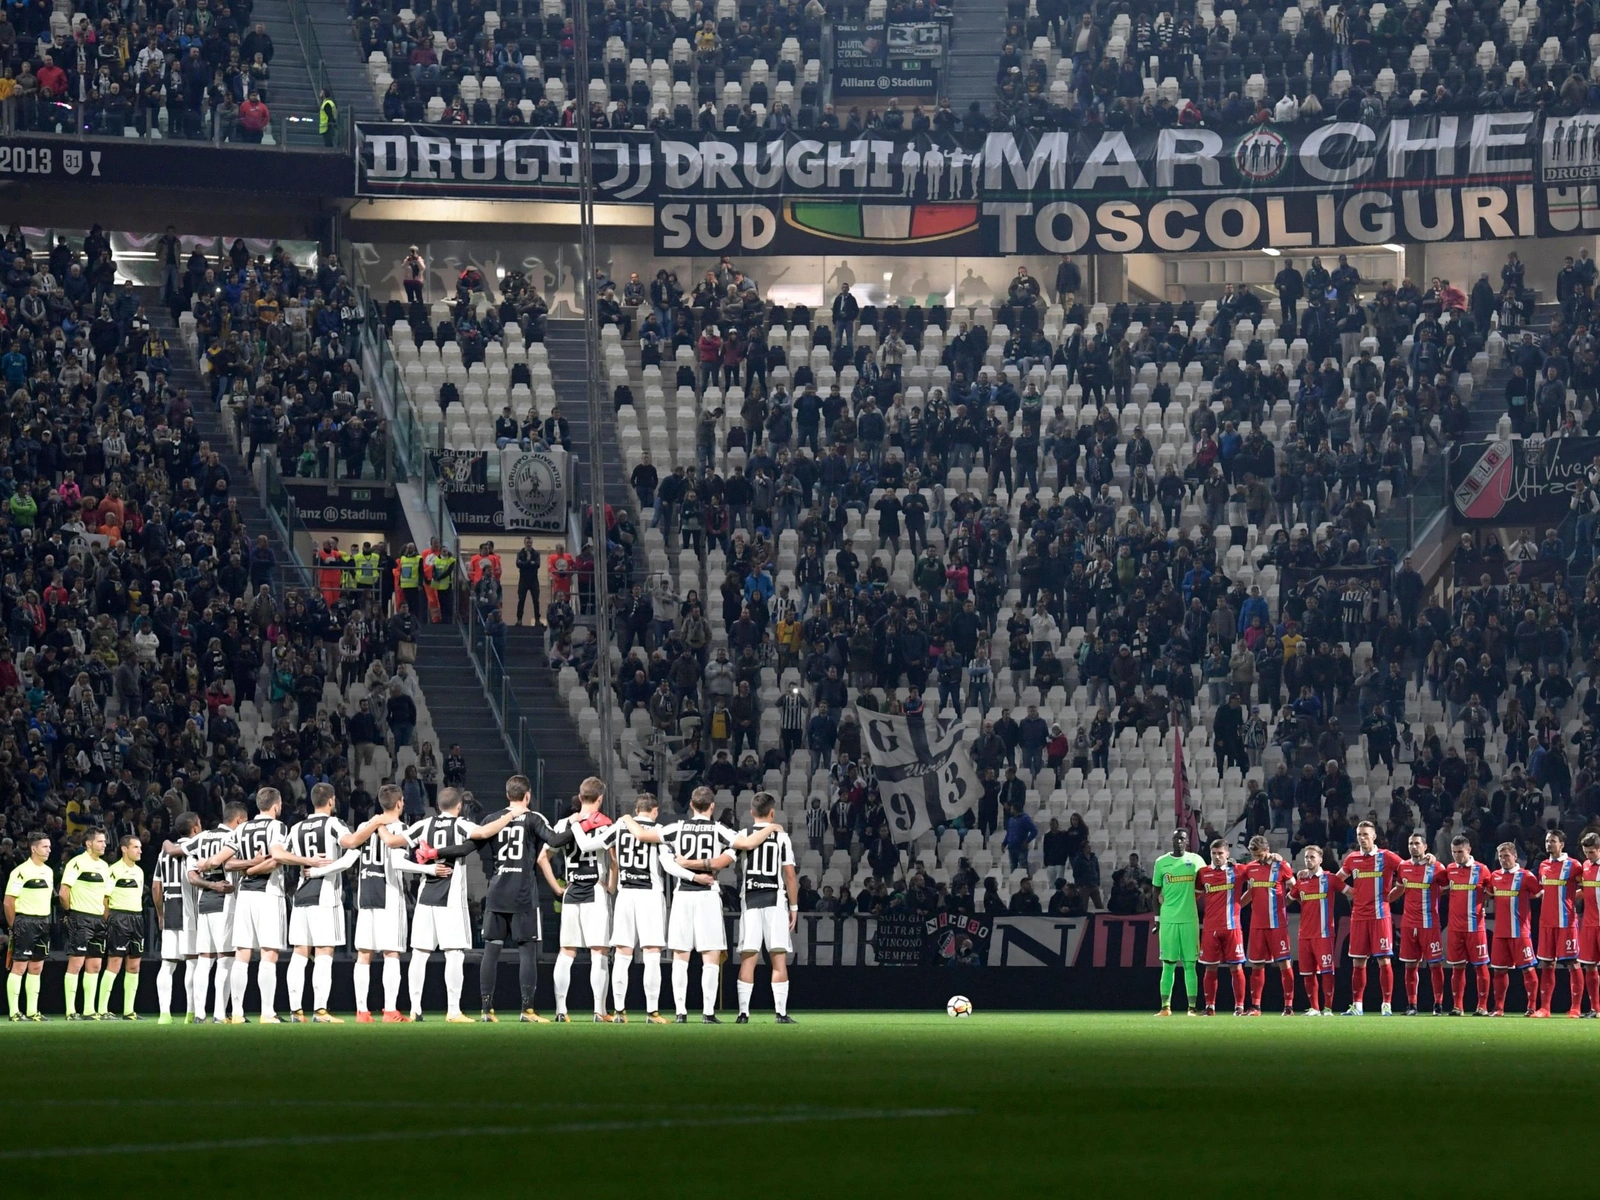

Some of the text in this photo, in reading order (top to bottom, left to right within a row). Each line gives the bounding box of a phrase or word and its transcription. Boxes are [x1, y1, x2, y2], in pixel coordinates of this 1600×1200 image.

[841, 78, 932, 87] Allianz Stadium
[0, 147, 52, 173] 2013
[65, 155, 80, 168] 31
[661, 140, 894, 189] DRUGHI
[661, 203, 776, 250] SUD
[982, 184, 1535, 253] TOSCOLIGURI
[508, 453, 562, 489] GRUPPO JUVENTUS
[340, 508, 387, 520] Stadium
[510, 518, 560, 530] MILANO
[868, 719, 899, 753] G
[944, 761, 967, 804] 3
[890, 792, 916, 831] 9
[241, 830, 267, 860] 15
[498, 825, 524, 861] 23
[620, 833, 648, 869] 33
[682, 833, 713, 861] 26
[162, 854, 181, 887] 11
[747, 841, 778, 876] 10
[879, 937, 922, 948] VINCONO
[880, 925, 921, 936] ULTRAS
[878, 950, 920, 961] SEMPRE
[1280, 940, 1287, 951] 2
[1321, 954, 1333, 965] 29
[1523, 947, 1532, 958] 18
